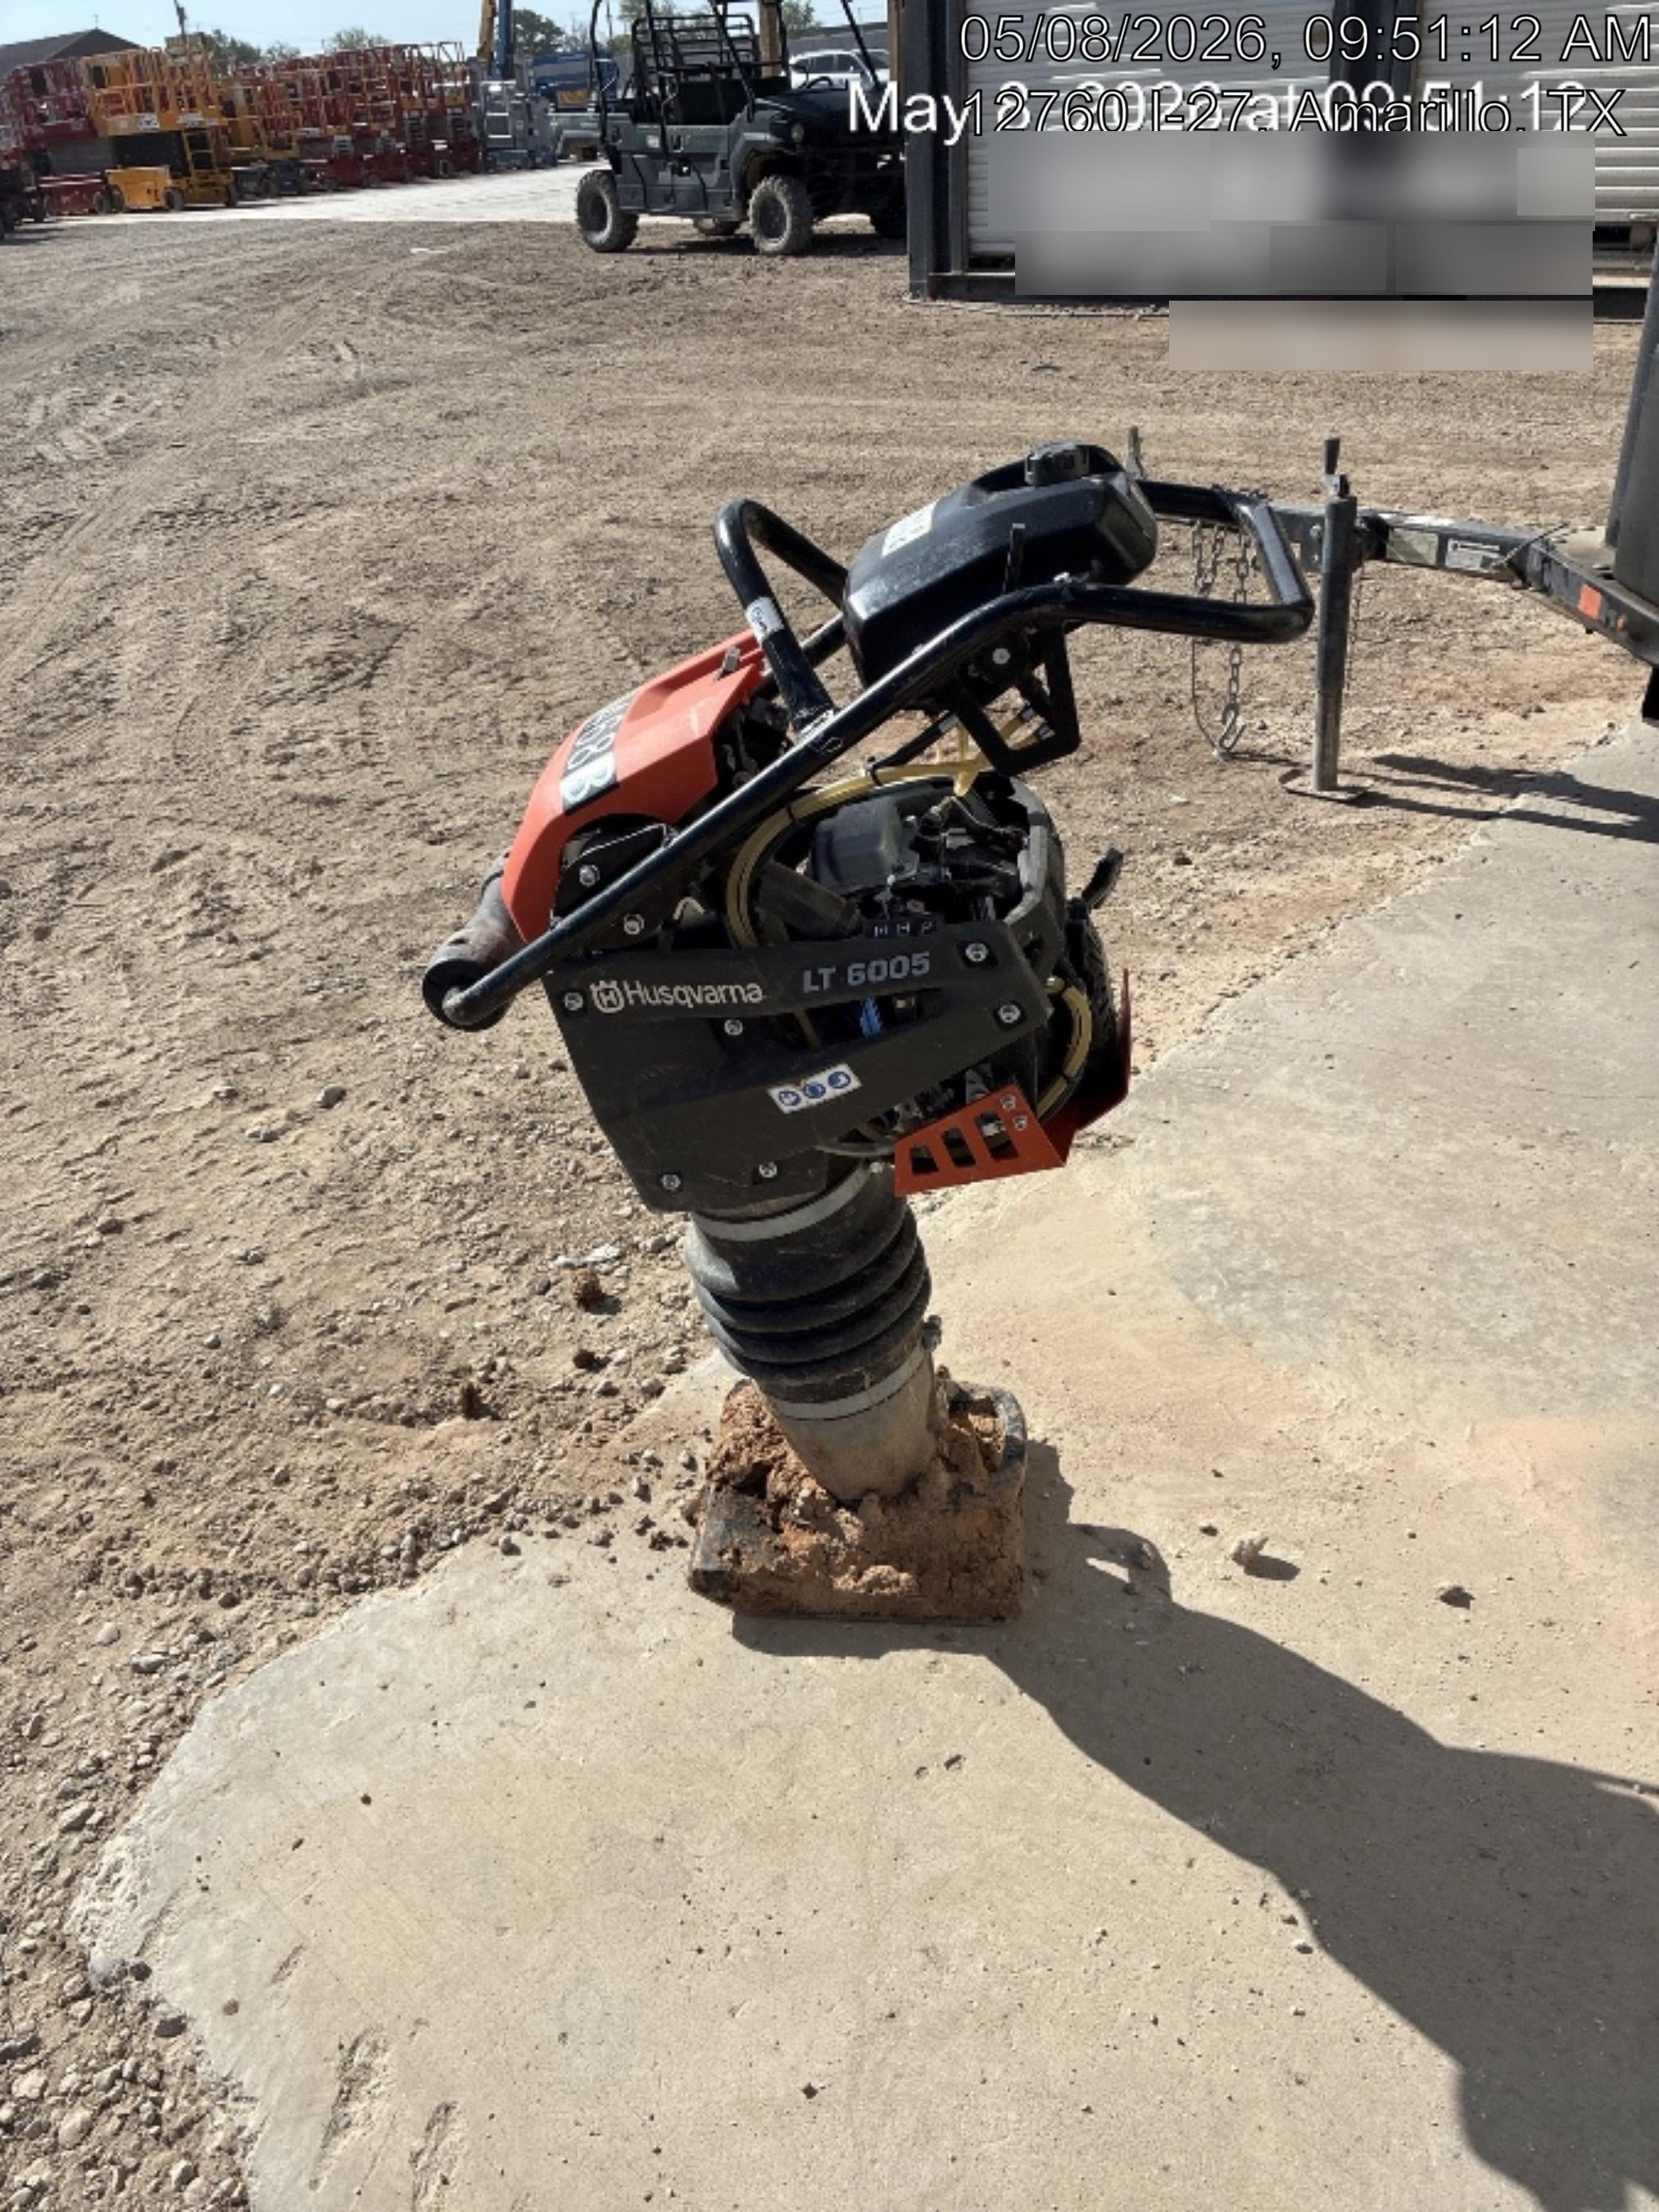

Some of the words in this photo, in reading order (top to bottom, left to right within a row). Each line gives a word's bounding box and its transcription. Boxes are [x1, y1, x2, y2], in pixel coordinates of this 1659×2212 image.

[802, 966, 836, 994] LT
[846, 951, 930, 986] 6005
[623, 980, 763, 1009] Husqvarna
